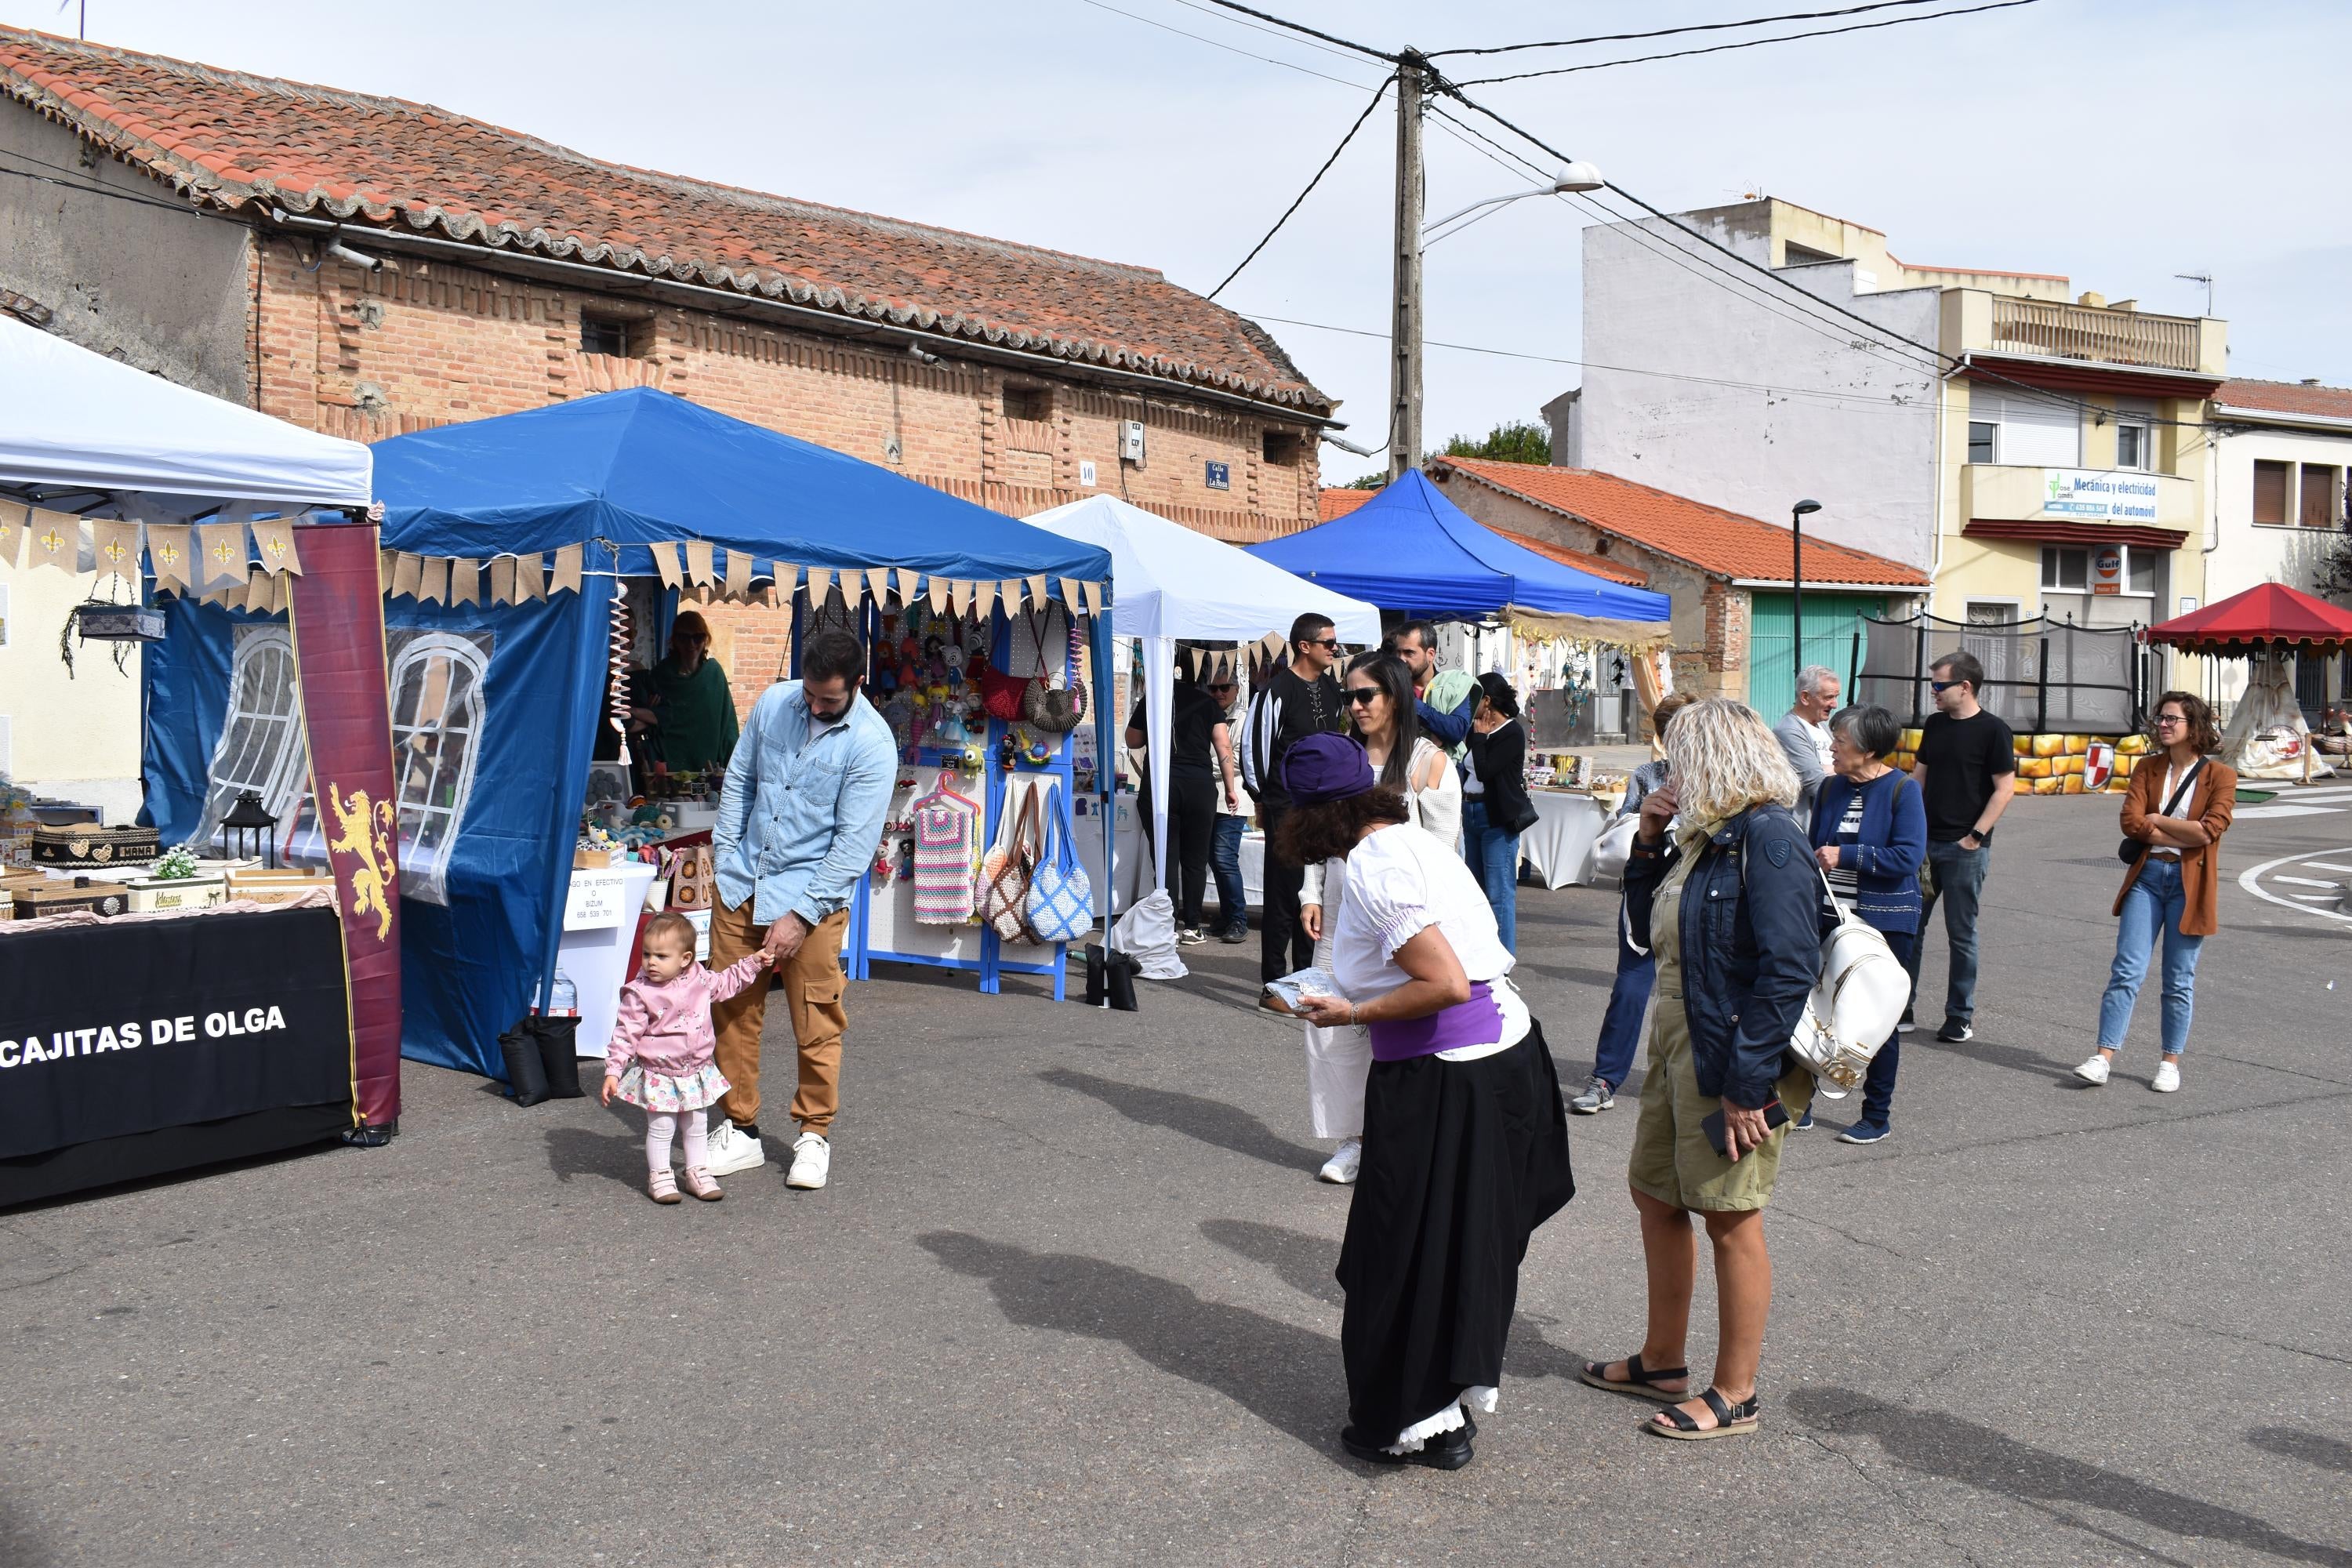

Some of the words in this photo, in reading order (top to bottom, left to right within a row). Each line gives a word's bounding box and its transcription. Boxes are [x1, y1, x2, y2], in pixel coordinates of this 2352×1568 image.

[1212, 464, 1224, 473] Calle
[1216, 479, 1228, 488] Rosa
[2074, 477, 2110, 492] Mecánica
[2112, 483, 2116, 495] y
[2118, 481, 2156, 496] electricidad
[2112, 503, 2122, 515] del
[2125, 506, 2155, 518] automóvil
[124, 847, 151, 856] MAMA
[0, 1022, 143, 1068] CAJITAS
[151, 1015, 196, 1045] DE
[204, 1005, 286, 1038] OLGA
